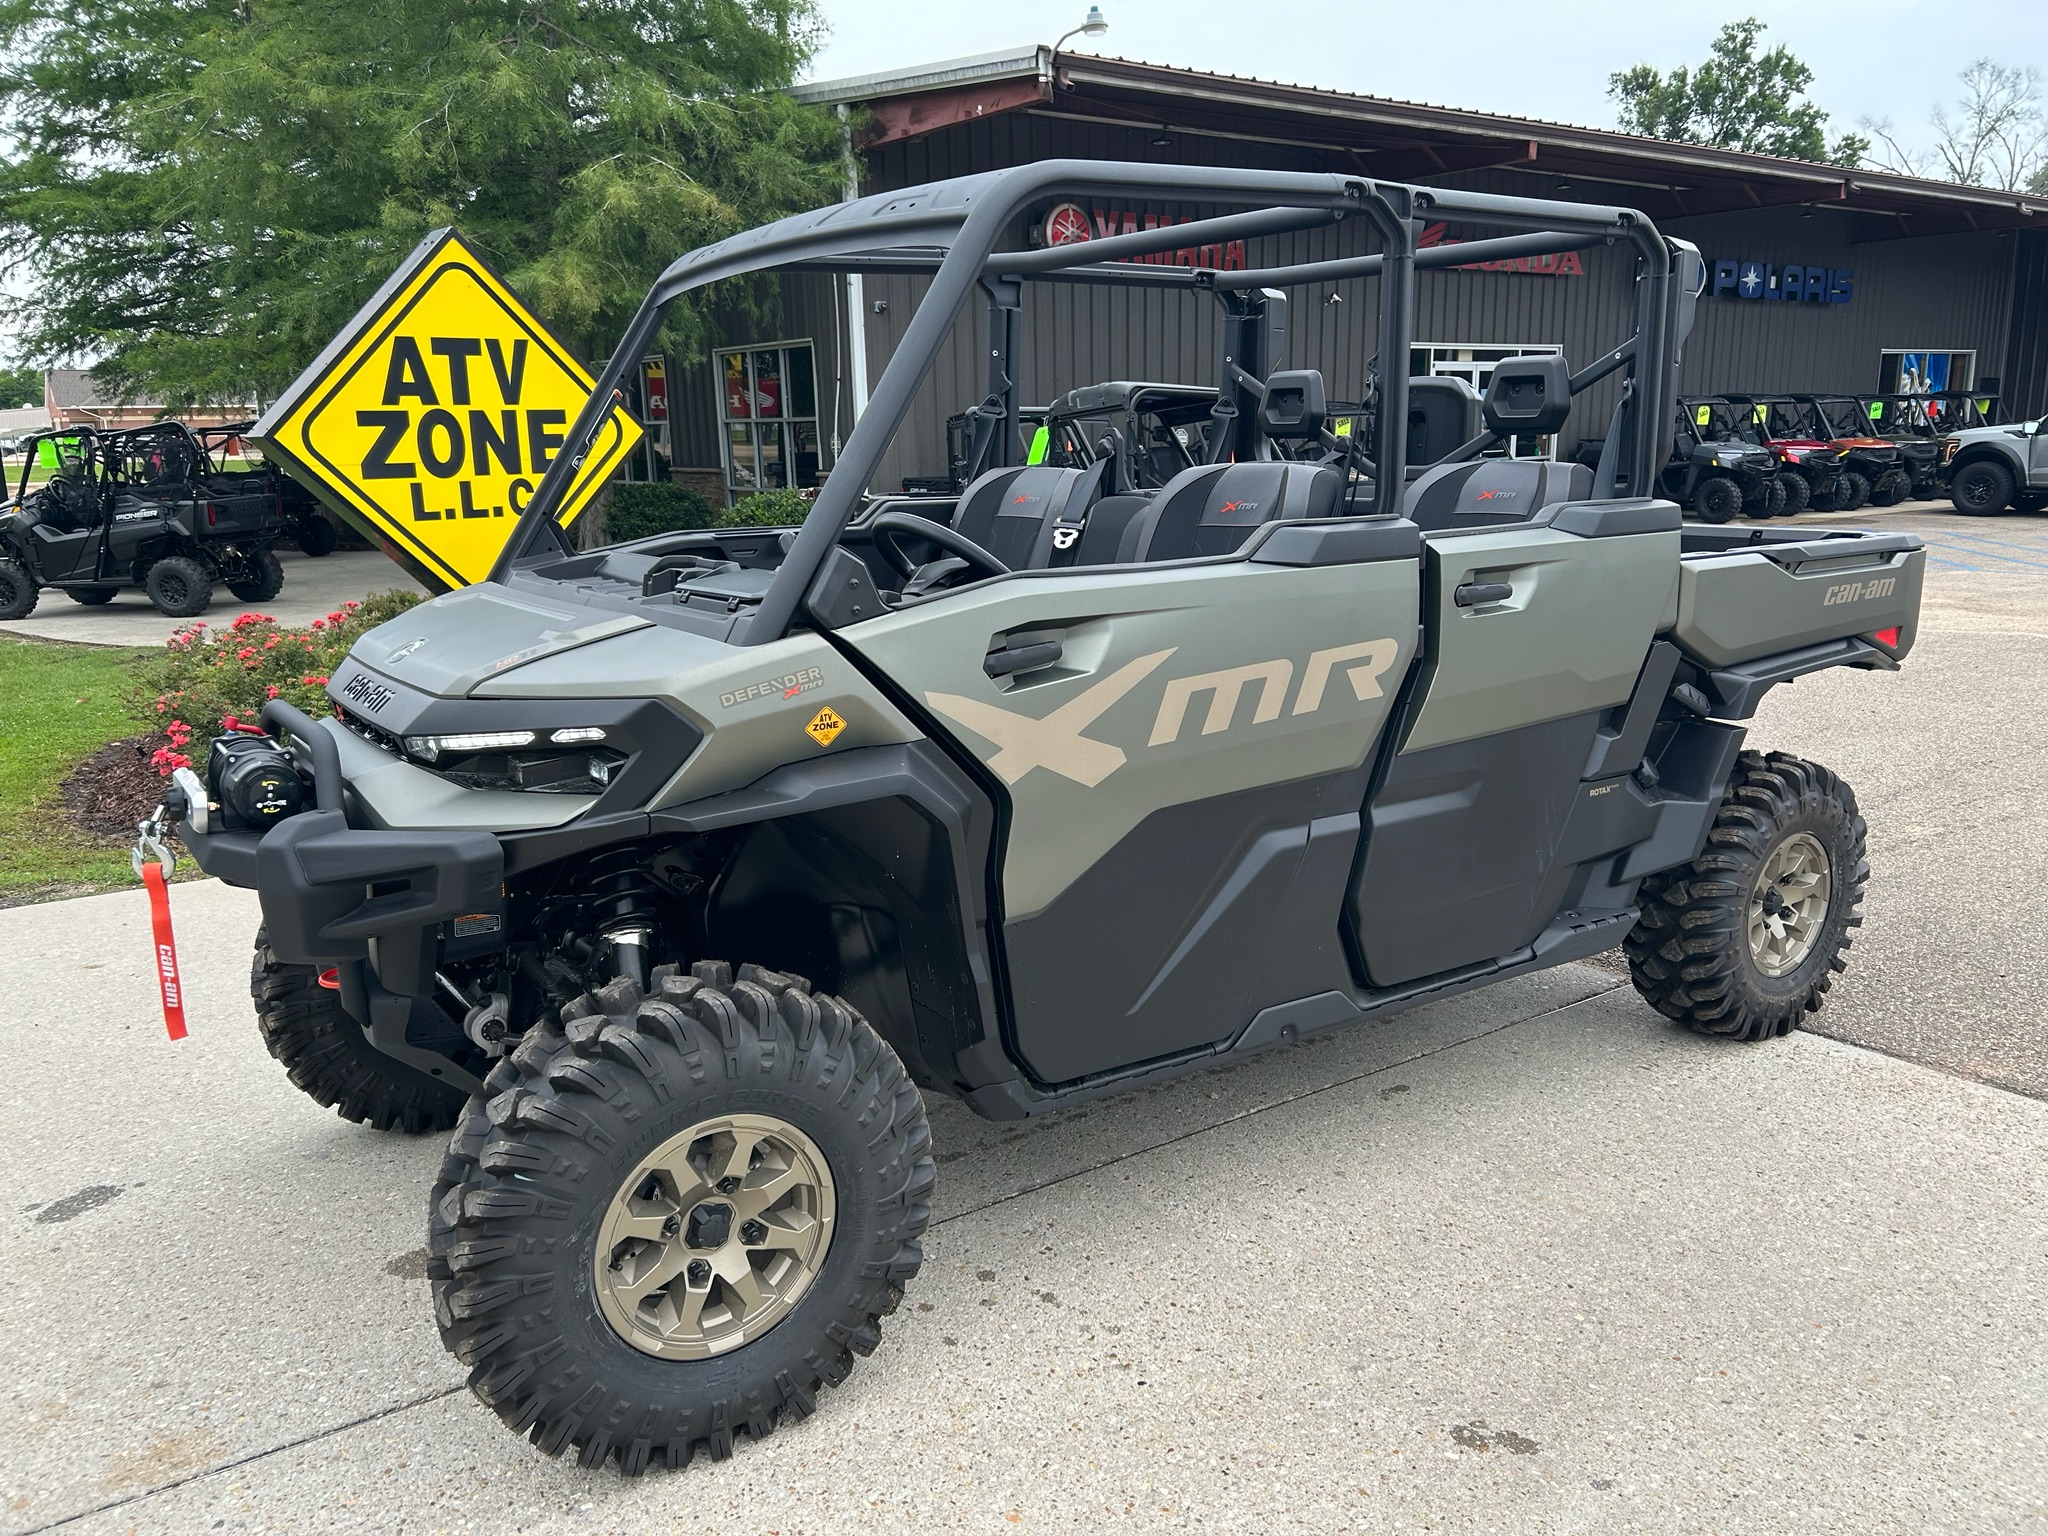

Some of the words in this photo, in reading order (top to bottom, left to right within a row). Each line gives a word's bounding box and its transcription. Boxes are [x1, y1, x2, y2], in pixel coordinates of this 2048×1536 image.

[1712, 260, 1854, 304] POLARIS
[381, 336, 529, 405] ATV
[356, 408, 567, 480] ZONE
[115, 509, 158, 521] PIONEER
[1823, 578, 1896, 606] can-am
[721, 667, 821, 707] DEFENDER
[813, 720, 839, 732] ZONE
[819, 713, 833, 723] ATV
[1589, 785, 1611, 797] ROTAX
[159, 944, 179, 1008] can-am
[727, 1088, 822, 1119] FORCE
